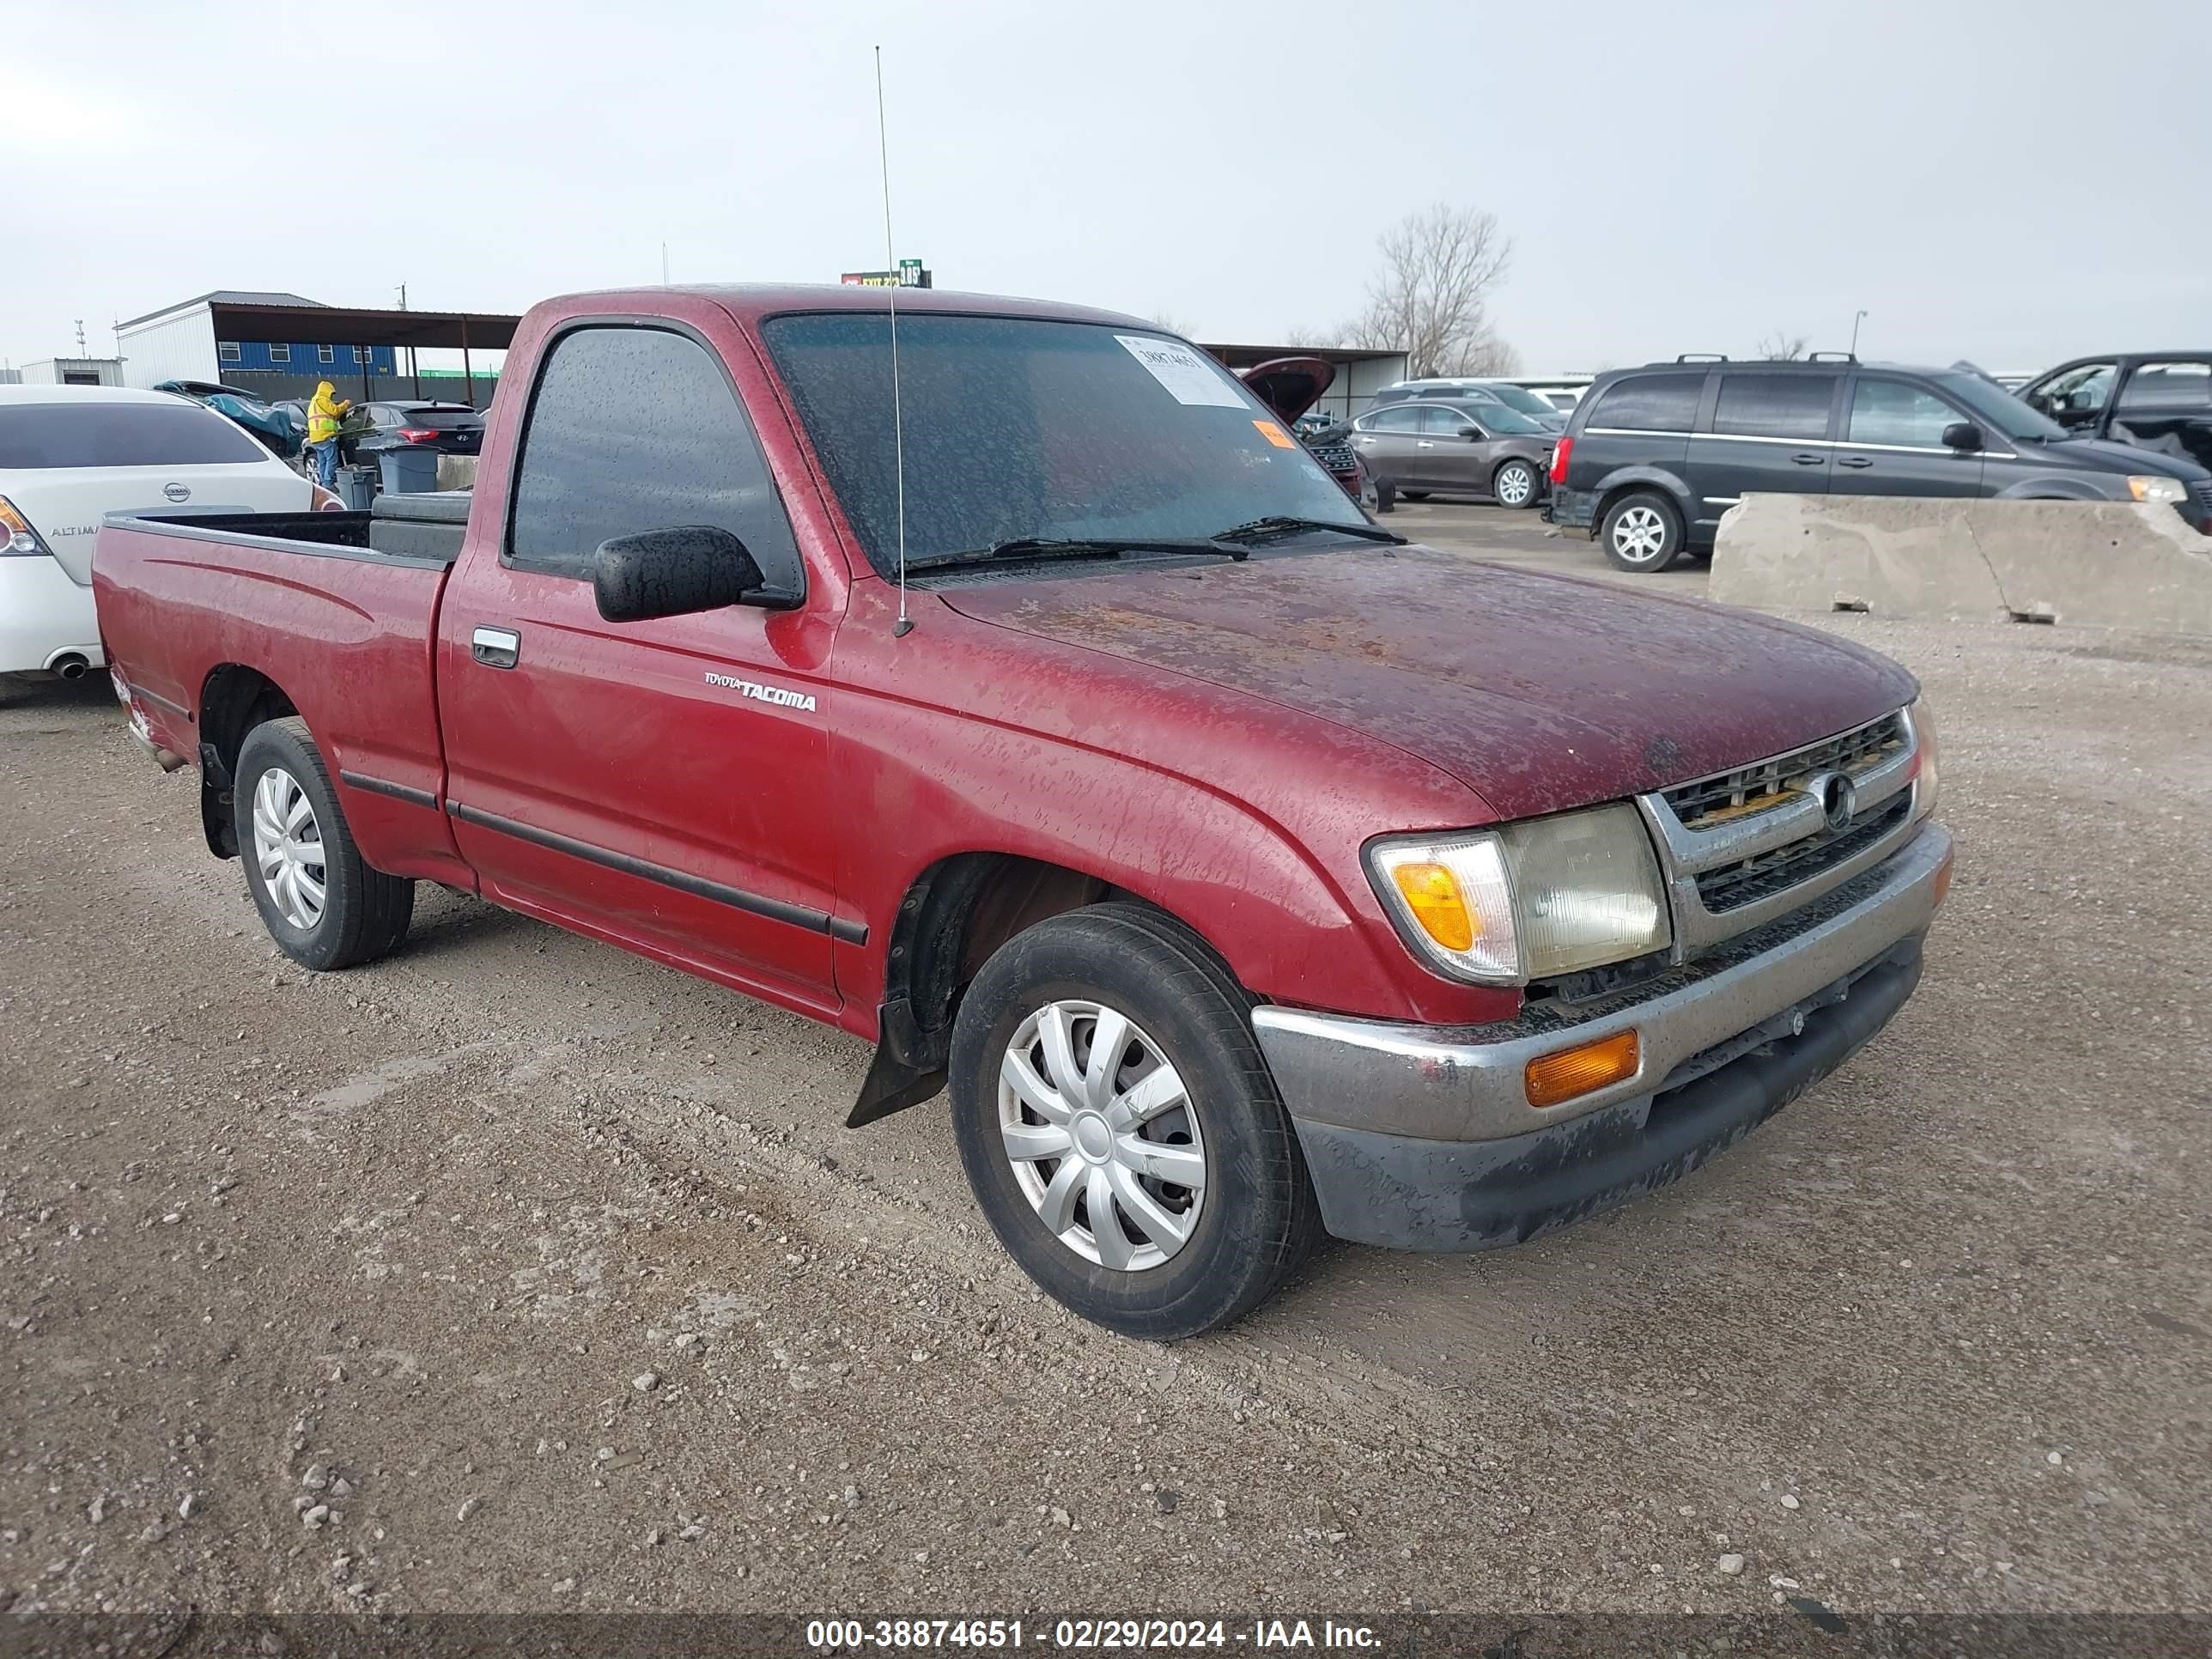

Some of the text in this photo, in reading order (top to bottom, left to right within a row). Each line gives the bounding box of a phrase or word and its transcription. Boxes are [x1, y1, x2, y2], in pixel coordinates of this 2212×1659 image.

[1139, 349, 1201, 368] 38874651
[704, 672, 817, 712] TOYOTA TACOMA
